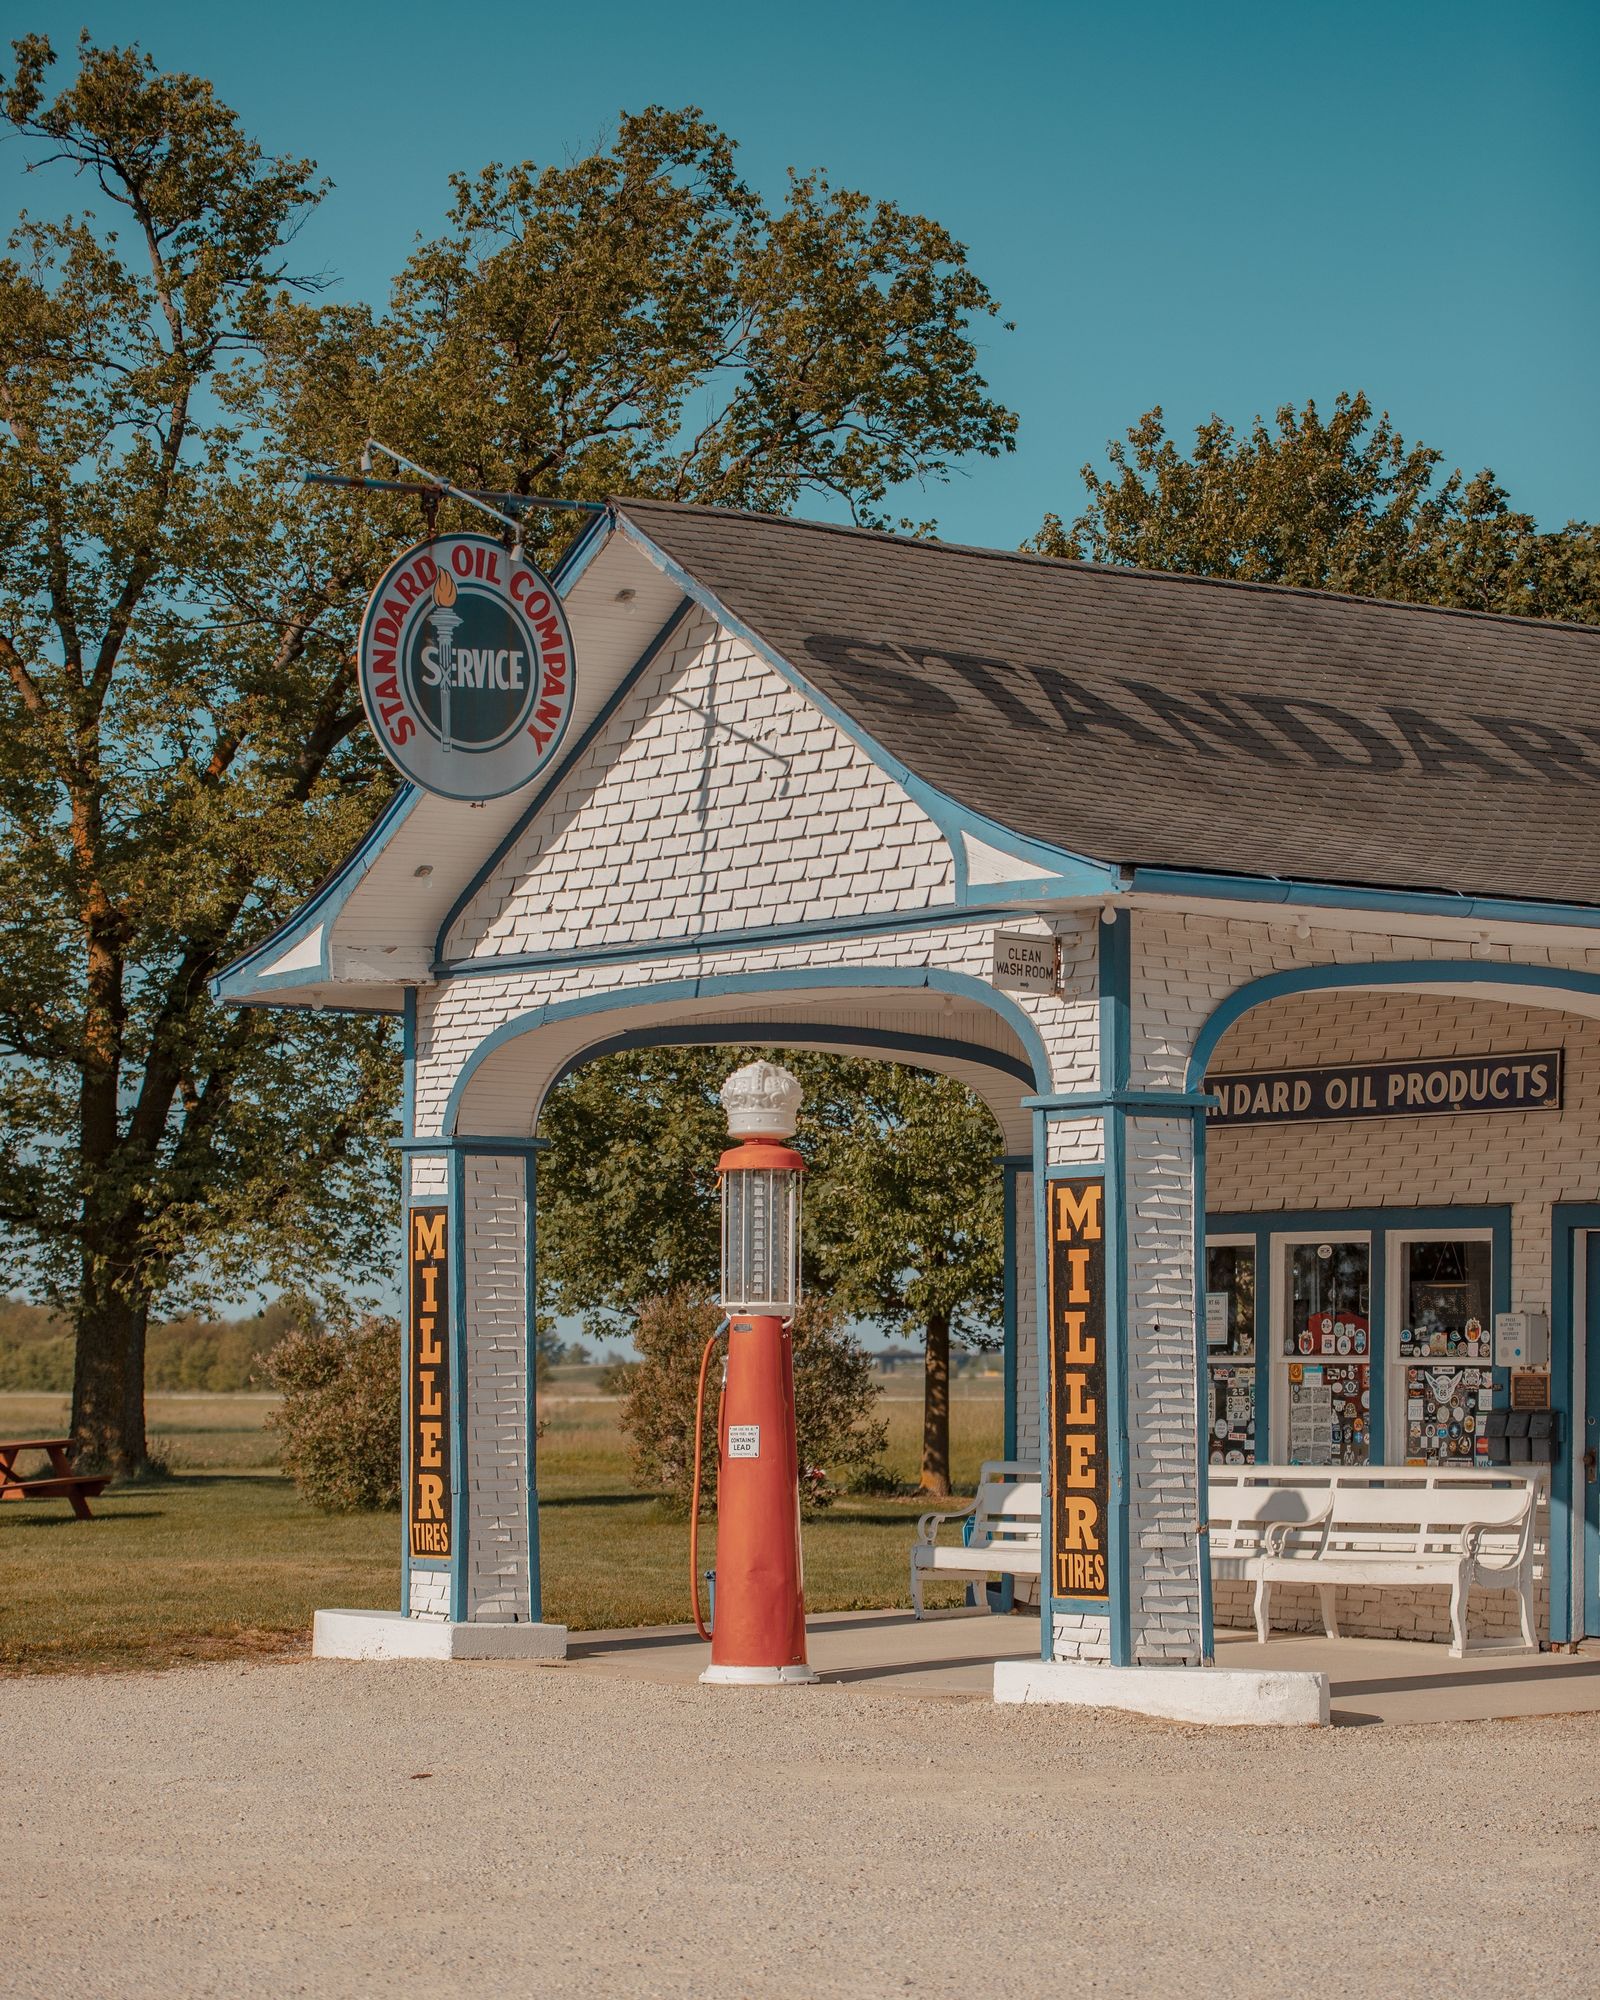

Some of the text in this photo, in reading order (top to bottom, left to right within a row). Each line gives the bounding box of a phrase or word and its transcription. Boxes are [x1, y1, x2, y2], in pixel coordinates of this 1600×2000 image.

[373, 544, 566, 756] STANDARD OIL COMPANY
[420, 646, 524, 690] SERVICE
[801, 634, 1600, 787] STANDAR
[996, 961, 1054, 980] WASH ROOM
[1008, 947, 1042, 963] CLEAN
[1203, 1064, 1548, 1117] NDARD OIL PRODUCTS
[415, 1214, 446, 1520] MILLER
[1056, 1185, 1102, 1550] MILLER
[1439, 1389, 1447, 1397] 66
[413, 1522, 449, 1553] TIRES
[1058, 1553, 1105, 1590] TIRES
